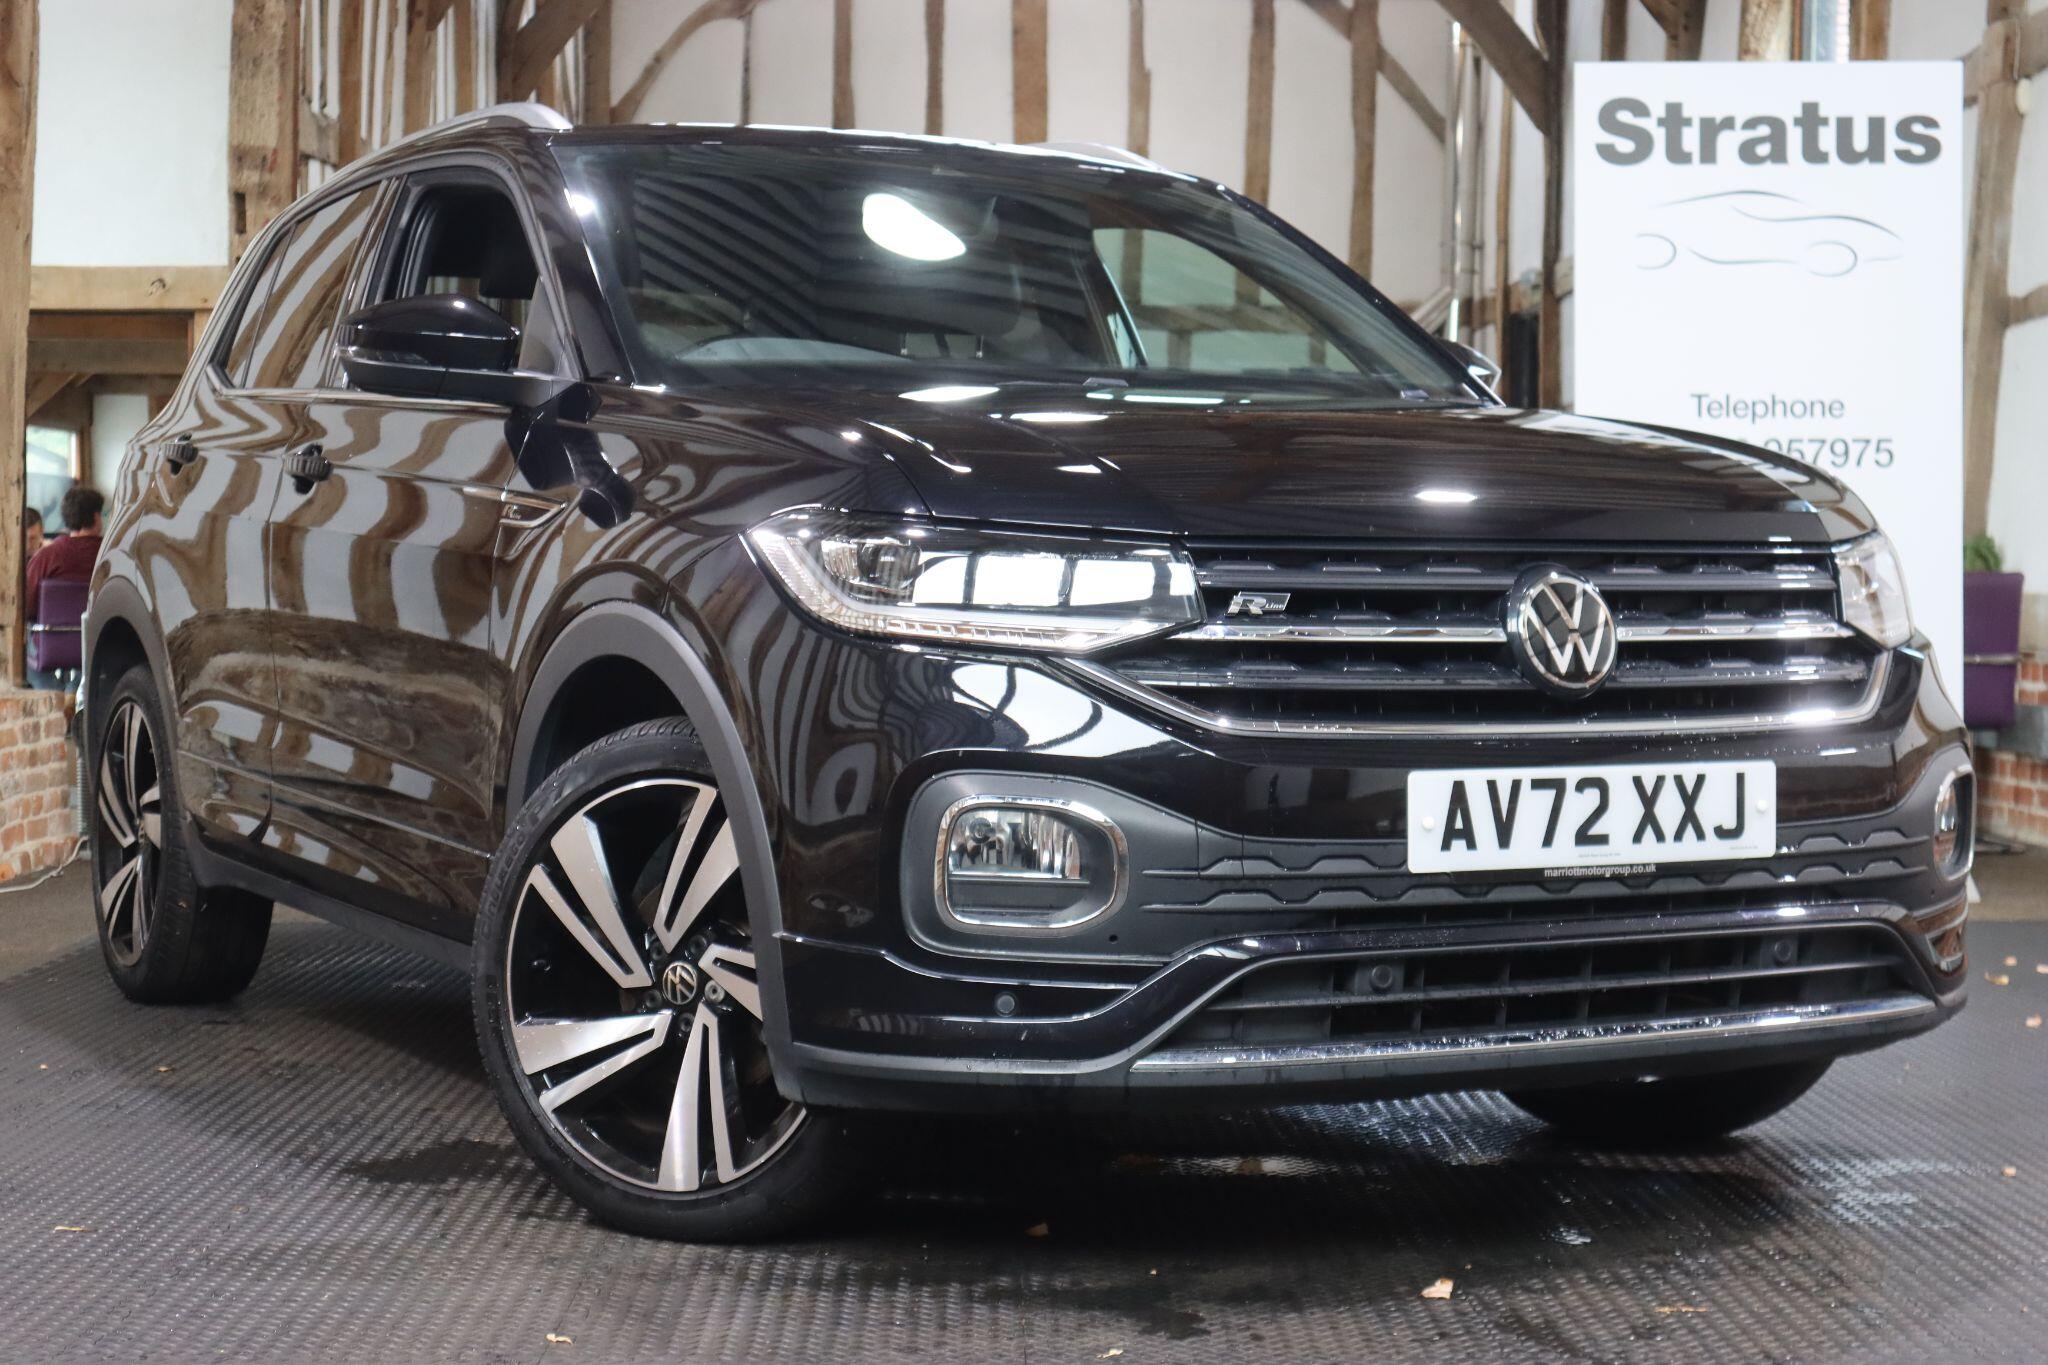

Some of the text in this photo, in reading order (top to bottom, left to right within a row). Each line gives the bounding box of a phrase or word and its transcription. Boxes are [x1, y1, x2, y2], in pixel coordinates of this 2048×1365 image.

[1596, 97, 1942, 166] Stratus
[1690, 393, 1845, 424] Telephone
[1440, 771, 1746, 852] AV72 XXJ
[1544, 863, 1657, 877] marriottmotorgroup.co.uk
